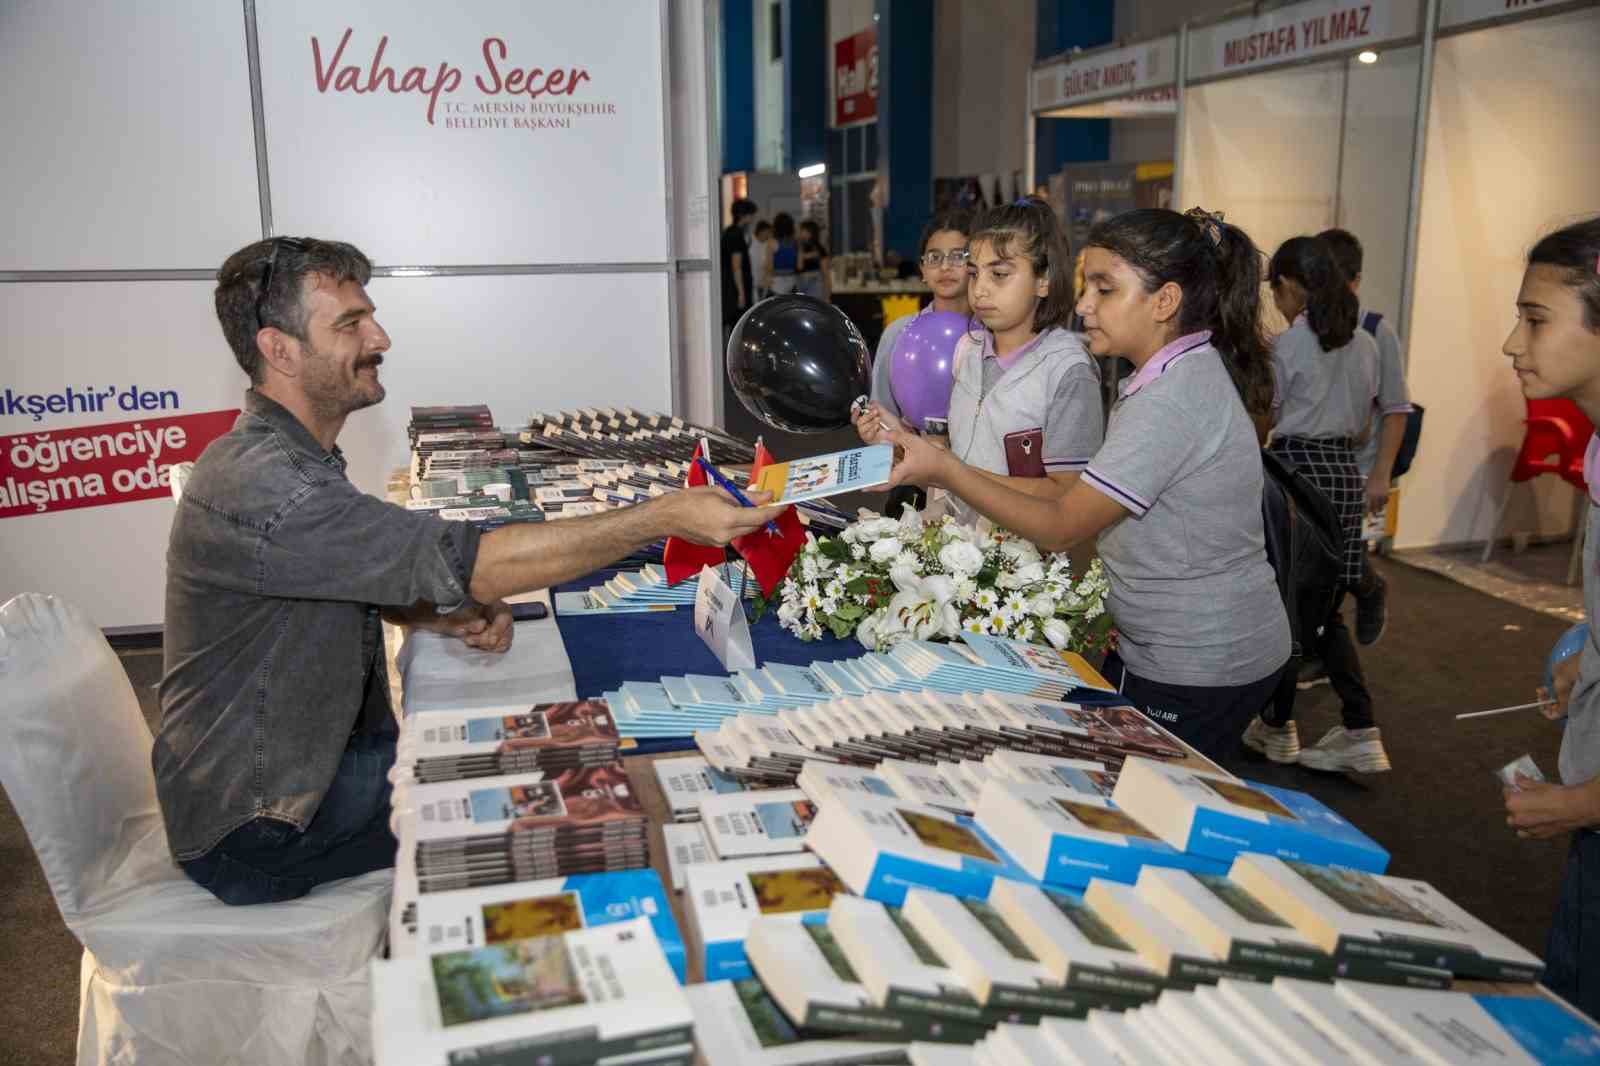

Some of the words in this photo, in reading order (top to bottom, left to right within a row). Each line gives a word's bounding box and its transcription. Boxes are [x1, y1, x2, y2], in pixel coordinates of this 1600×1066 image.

[1224, 24, 1297, 66] MUSTAFA
[1302, 4, 1372, 48] YILMAZ
[310, 27, 462, 125] Vahap
[475, 37, 591, 99] Seçer
[445, 115, 508, 129] BELEDİYE
[512, 116, 572, 131] BAŞKANI
[472, 100, 526, 114] MERSİN
[0, 385, 180, 422] kşehir'den
[10, 423, 187, 474] öğrenciye
[1162, 711, 1179, 723] ARE
